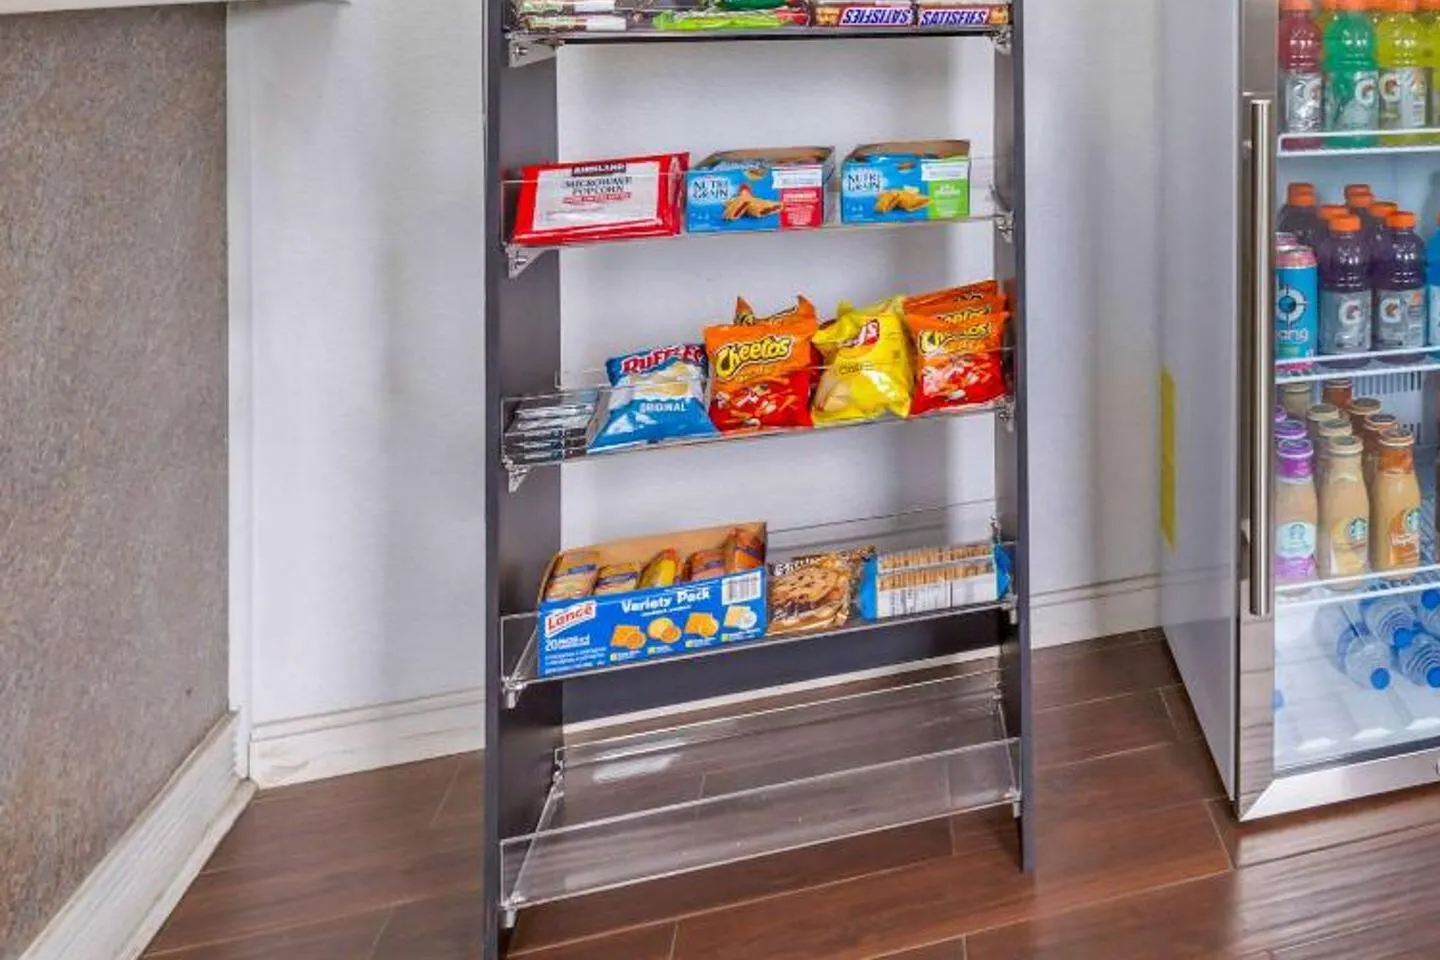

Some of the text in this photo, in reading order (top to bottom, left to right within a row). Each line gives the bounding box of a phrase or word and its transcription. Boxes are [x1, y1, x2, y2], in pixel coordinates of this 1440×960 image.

[842, 8, 911, 25] SATISFIES
[921, 9, 987, 26] SATISFIES
[715, 336, 792, 378] Cheetos
[621, 597, 672, 613] Variety
[676, 588, 710, 604] Pack
[548, 604, 593, 632] Lance
